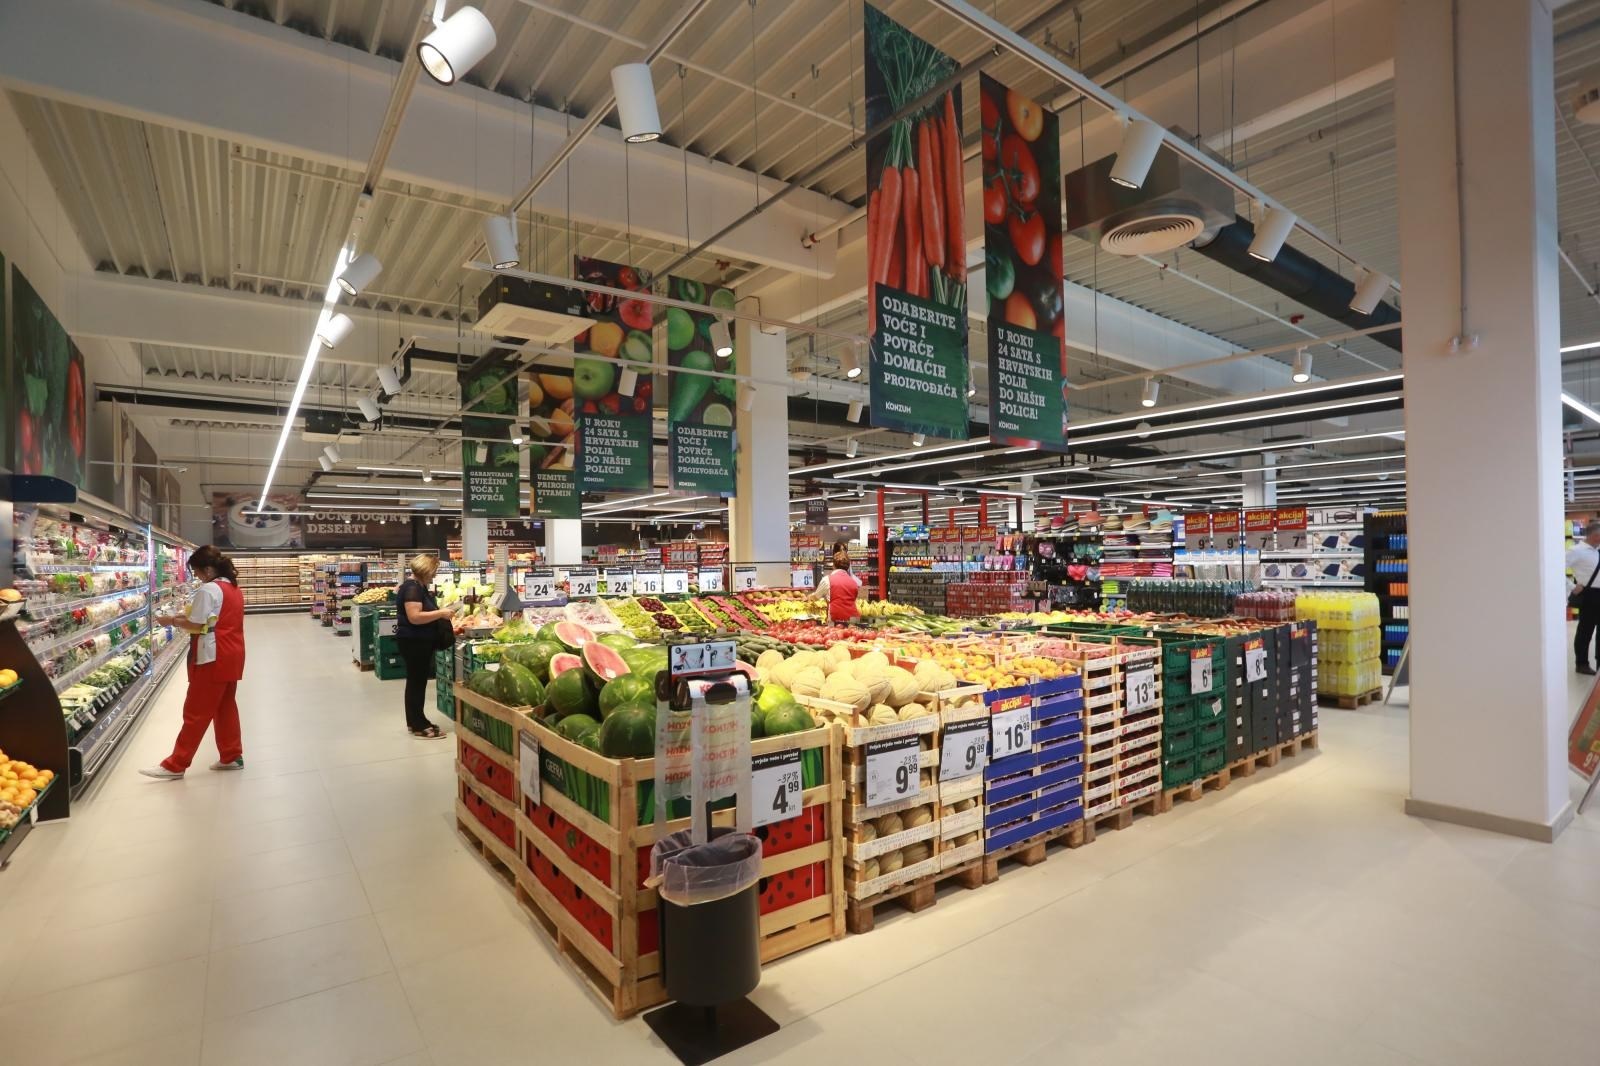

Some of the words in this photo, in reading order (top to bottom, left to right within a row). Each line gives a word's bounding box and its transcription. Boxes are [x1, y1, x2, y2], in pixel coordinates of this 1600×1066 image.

[883, 296, 956, 330] ODABERITE
[883, 314, 917, 336] VOĆE
[920, 325, 926, 338] I
[998, 328, 1004, 340] U
[1007, 330, 1033, 348] ROKU
[883, 332, 934, 358] POVRĆE
[998, 343, 1008, 356] 24
[1010, 347, 1033, 363] SATA
[1036, 353, 1041, 364] S
[884, 351, 946, 378] DOMAĆIH
[999, 357, 1053, 380] HRVATSKIH
[999, 372, 1028, 389] POLJA
[999, 386, 1013, 400] DO
[1017, 390, 1046, 407] NAŠIH
[886, 401, 911, 414] KONZUM
[1000, 401, 1038, 420] POLICA!
[594, 419, 621, 429] ROKU
[998, 420, 1019, 432] KONZUM
[585, 427, 595, 436] 24
[597, 428, 620, 437] SATA
[678, 427, 728, 439] ODABERITE
[585, 437, 639, 448] HRVATSKIH
[678, 436, 702, 445] VOĆE
[586, 446, 614, 455] POLJA
[678, 446, 713, 456] POVRĆE
[585, 456, 600, 464] DO
[602, 456, 631, 466] NAŠIH
[678, 455, 721, 466] DOMAĆIH
[585, 465, 624, 474] POLICA!
[470, 477, 507, 485] SVJEŽINA
[1214, 514, 1237, 522] akcija!
[1247, 513, 1271, 521] akcija!
[1279, 512, 1304, 520] akcija!
[307, 523, 367, 534] DESERTI
[534, 584, 548, 596] 24
[578, 583, 591, 594] 24
[615, 582, 628, 592] 24
[644, 581, 656, 591] 16
[677, 580, 683, 590] 9
[392, 625, 398, 633] 3
[1256, 659, 1260, 676] 8
[1202, 670, 1208, 688] 6
[1135, 683, 1148, 704] 13
[1001, 697, 1021, 711] akcija!
[1005, 724, 1023, 750] 16
[965, 745, 976, 770] 9
[977, 744, 984, 753] 99
[777, 772, 798, 783] -37%
[896, 766, 908, 793] 9
[909, 763, 918, 774] 99
[773, 784, 788, 814] 4
[788, 781, 799, 792] 99
